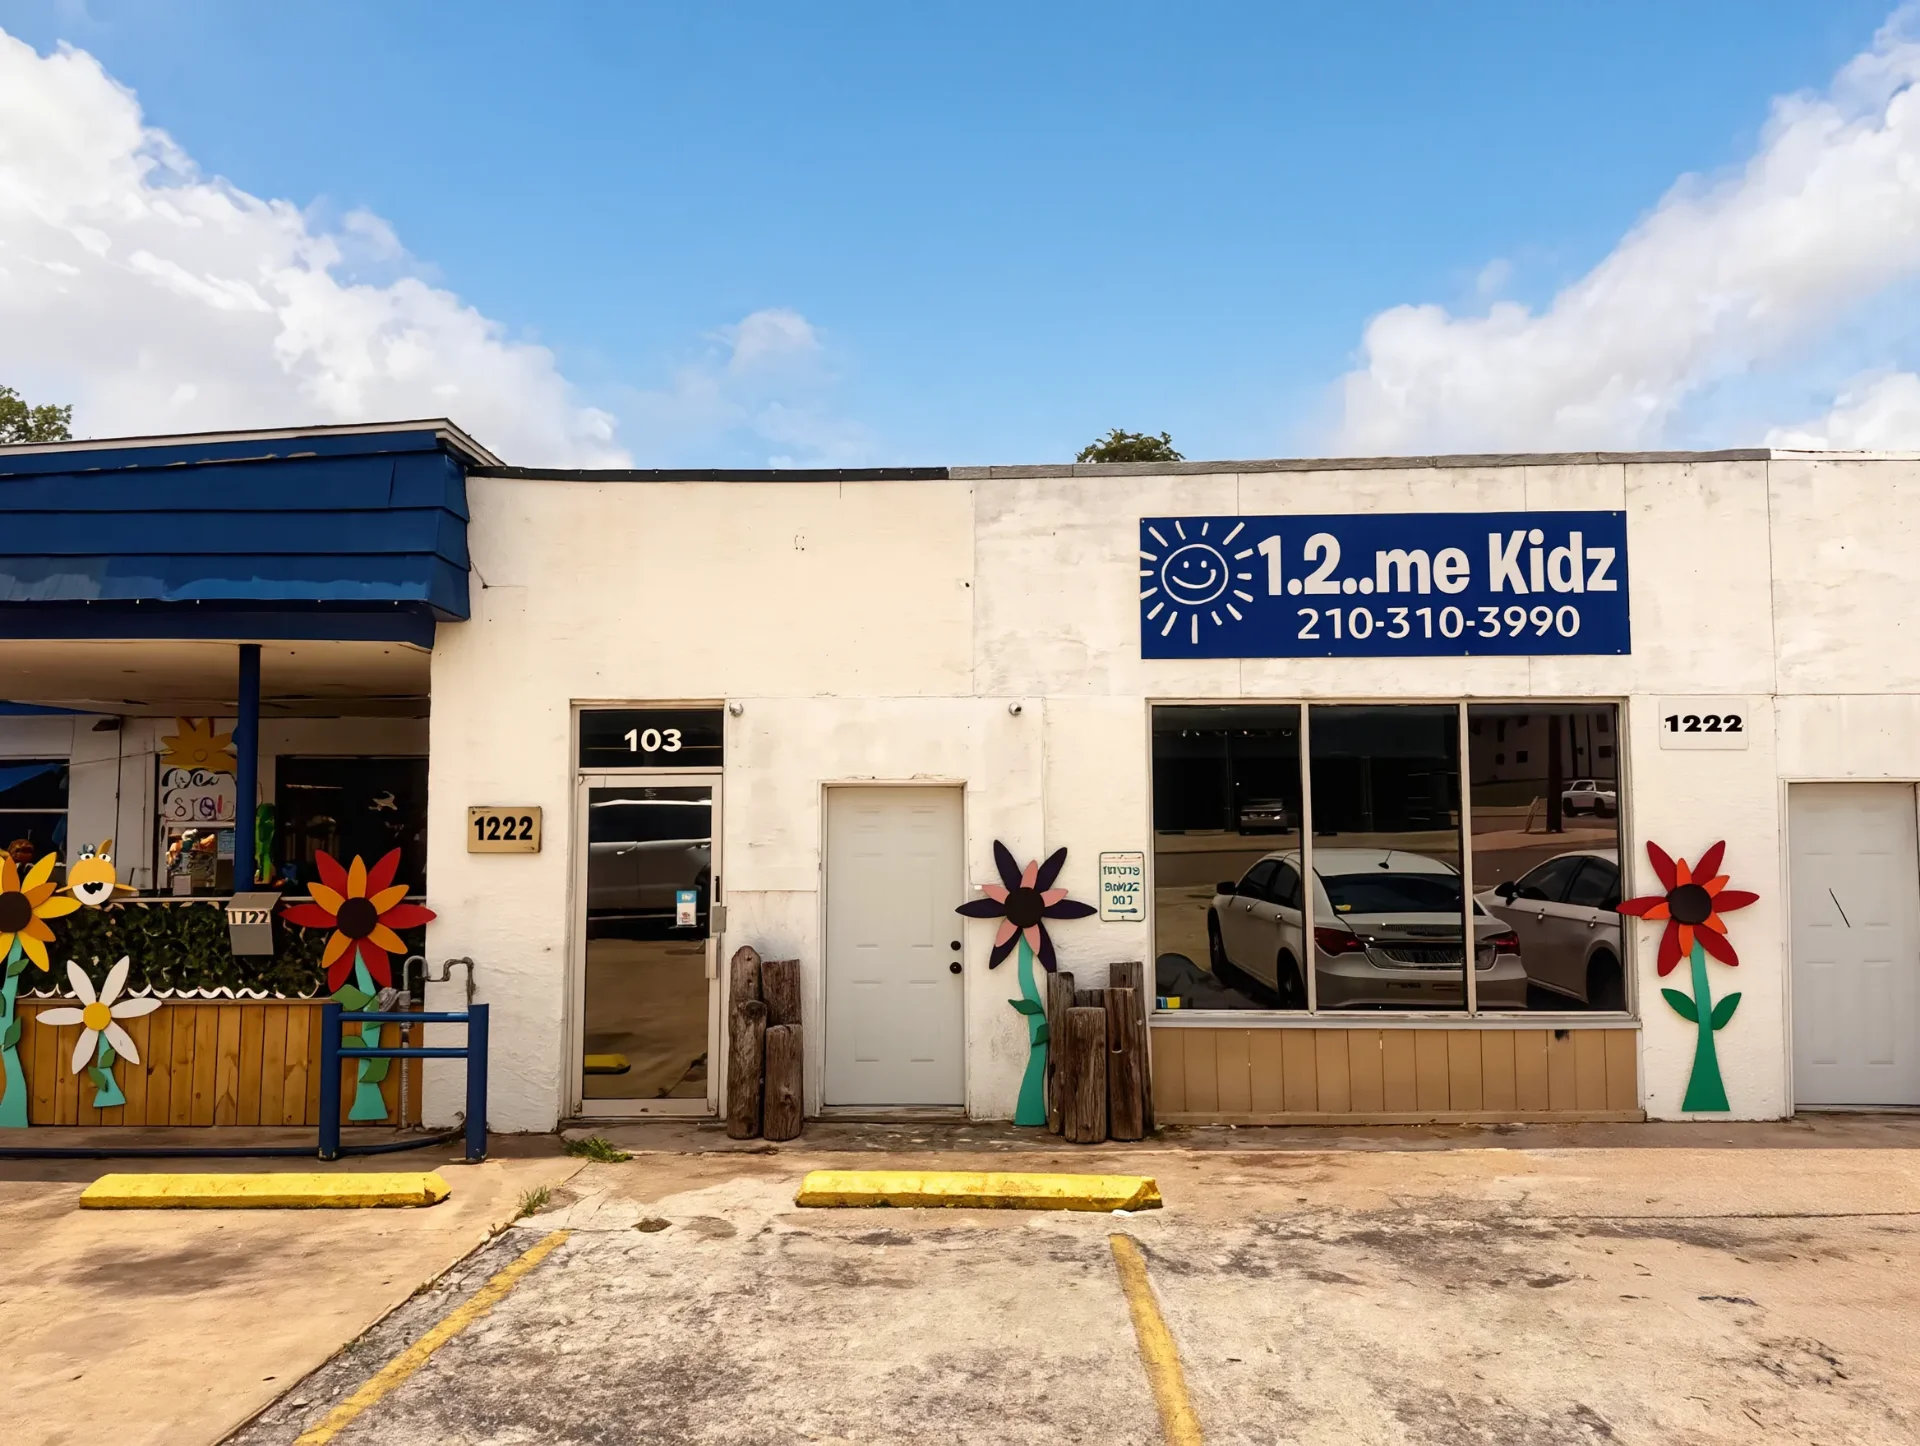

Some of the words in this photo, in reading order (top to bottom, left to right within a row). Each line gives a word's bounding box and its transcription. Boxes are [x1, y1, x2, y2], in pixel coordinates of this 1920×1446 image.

[1257, 532, 1470, 596] 1.2..me
[1488, 528, 1618, 595] Kidz
[1297, 605, 1580, 640] 210-310-3990
[1665, 714, 1743, 733] 1222
[624, 728, 682, 752] 103
[474, 815, 534, 841] 1222
